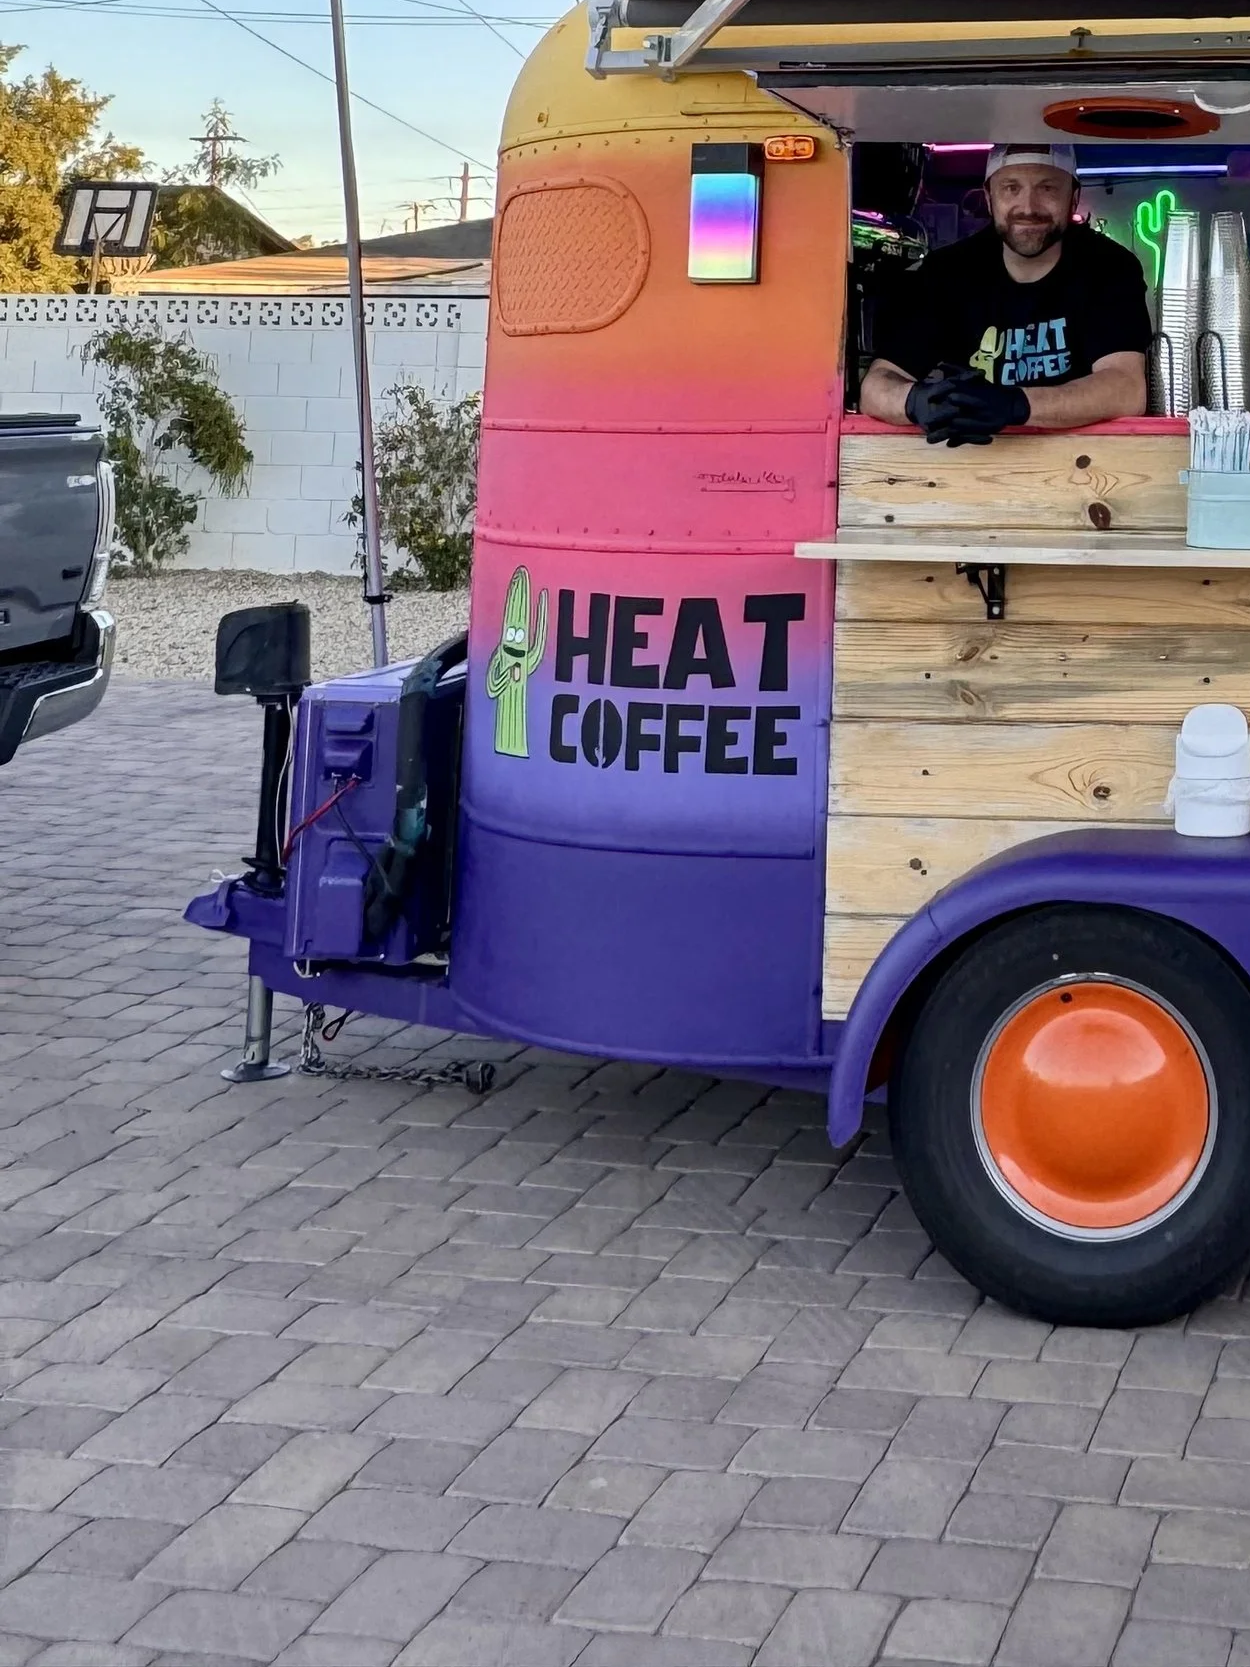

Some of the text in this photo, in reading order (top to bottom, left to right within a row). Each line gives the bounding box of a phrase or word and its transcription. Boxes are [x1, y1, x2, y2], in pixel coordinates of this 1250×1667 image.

[1001, 351, 1072, 386] COFFEE
[1005, 317, 1067, 361] HEAT
[555, 588, 806, 692] HEAT
[549, 694, 801, 776] COFFEE
